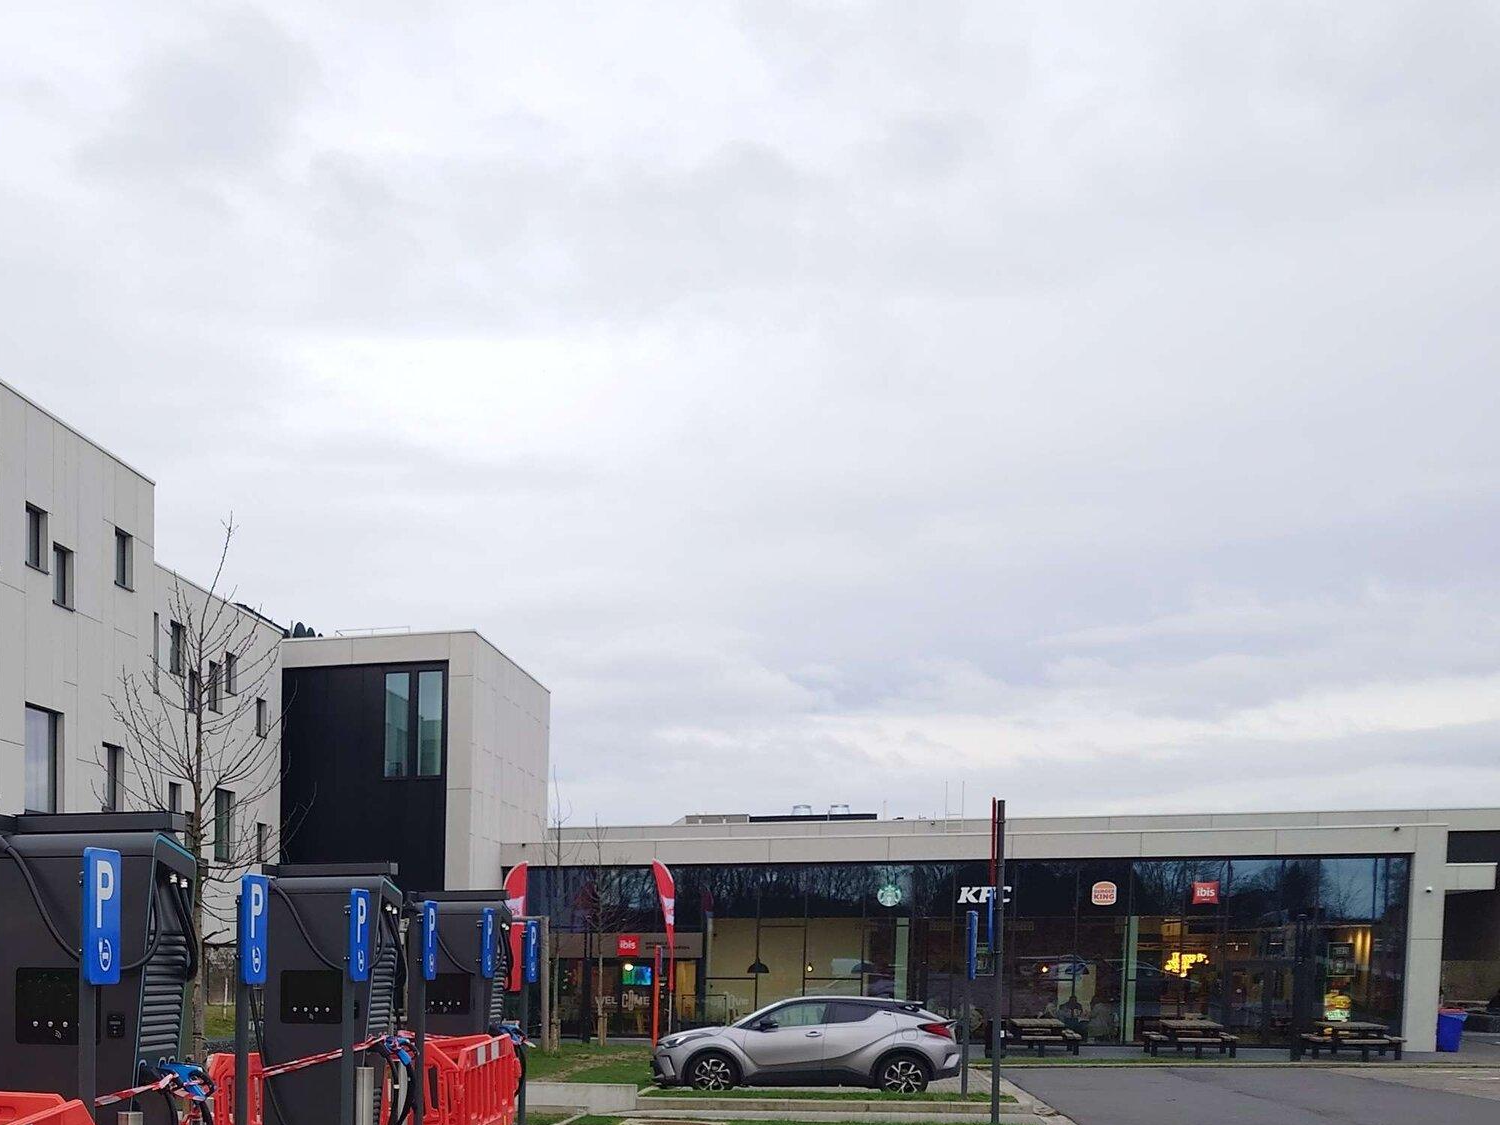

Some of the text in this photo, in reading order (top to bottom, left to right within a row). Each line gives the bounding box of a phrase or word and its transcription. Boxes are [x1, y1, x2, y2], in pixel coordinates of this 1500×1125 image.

[96, 860, 114, 928] P
[251, 883, 263, 938] P
[1196, 887, 1215, 896] ibis
[357, 896, 366, 943] P
[428, 908, 435, 948] P
[619, 940, 636, 949] ibis
